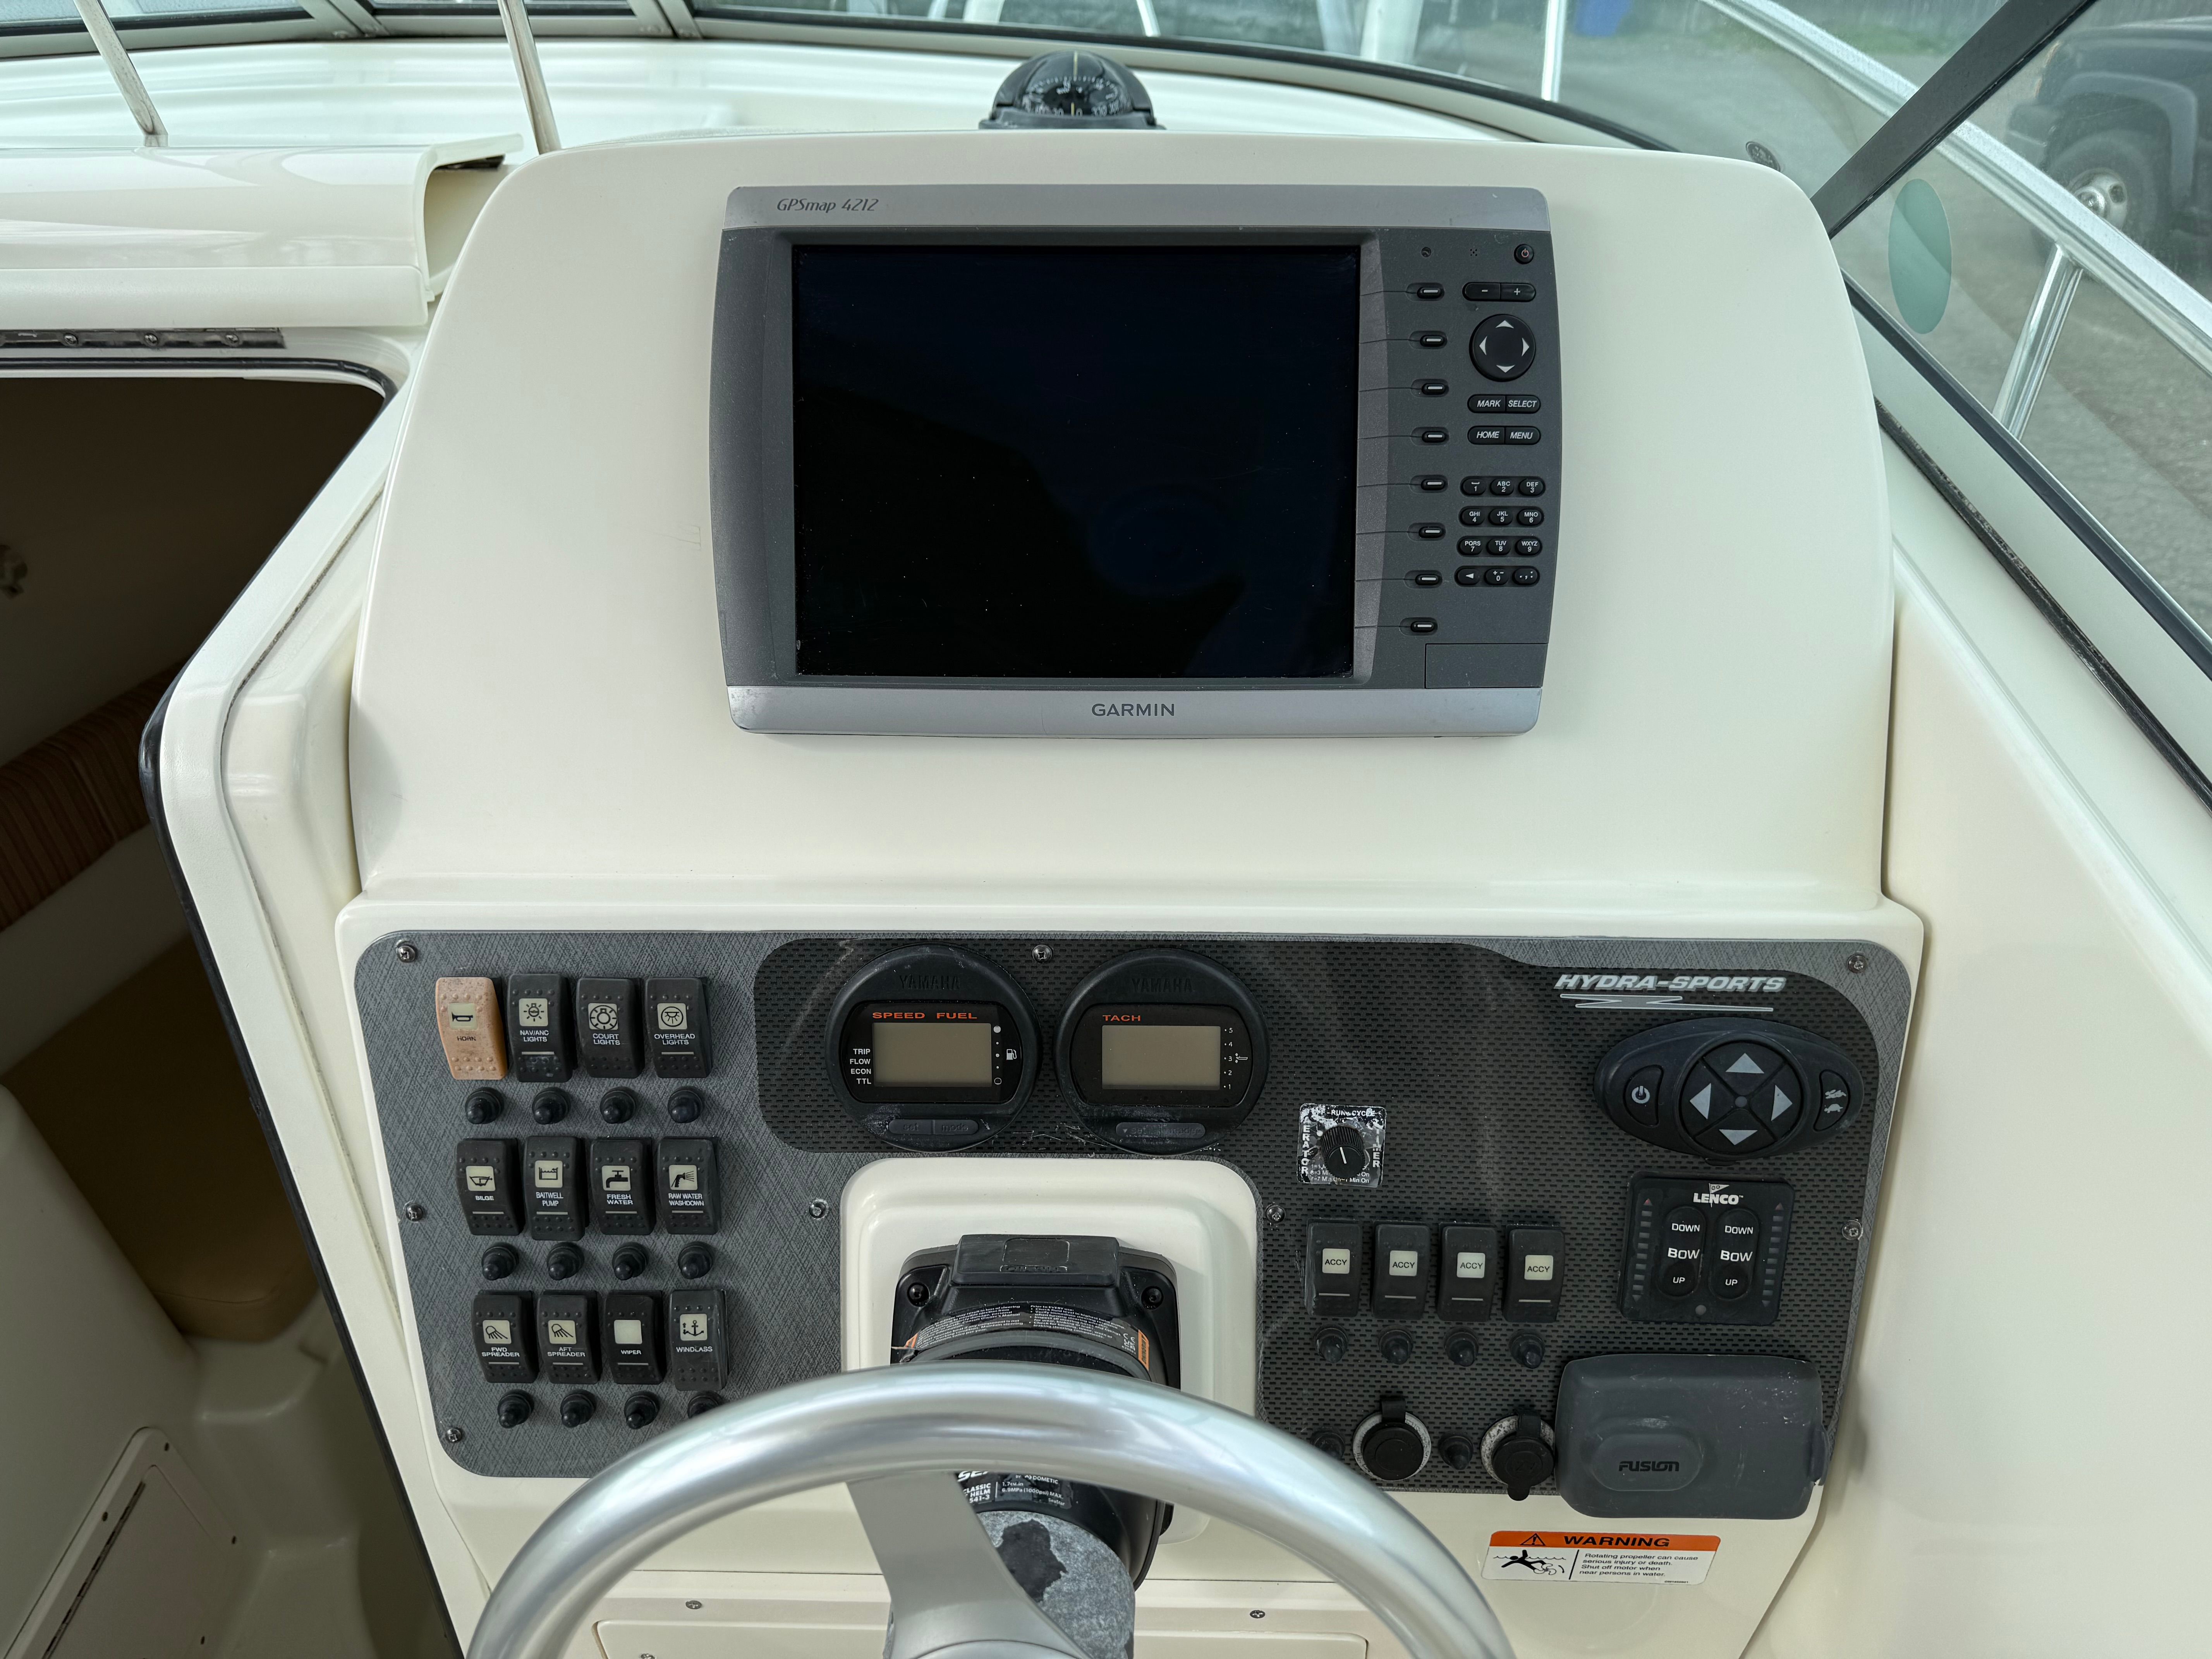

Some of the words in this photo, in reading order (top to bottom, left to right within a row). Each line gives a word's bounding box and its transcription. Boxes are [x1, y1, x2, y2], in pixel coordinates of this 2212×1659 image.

[777, 198, 836, 213] GPSmap
[841, 199, 879, 211] 4212
[1508, 400, 1537, 408] SELECT
[1092, 703, 1175, 716] GARMIN
[898, 975, 961, 990] YAMAHA
[1131, 977, 1193, 993] YAMAHA
[1553, 973, 1788, 993] HYDRA-SPORTS
[1693, 1192, 1739, 1205] LENCO
[1671, 1223, 1700, 1232] DOWN
[1724, 1225, 1753, 1235] DOWN
[1668, 1247, 1700, 1259] BOW
[1720, 1250, 1753, 1262] BOW
[1618, 1461, 1680, 1472] FUSION
[1032, 1475, 1059, 1484] DOMETIC
[969, 1489, 991, 1498] HELM
[1564, 1535, 1670, 1547] WARNING
